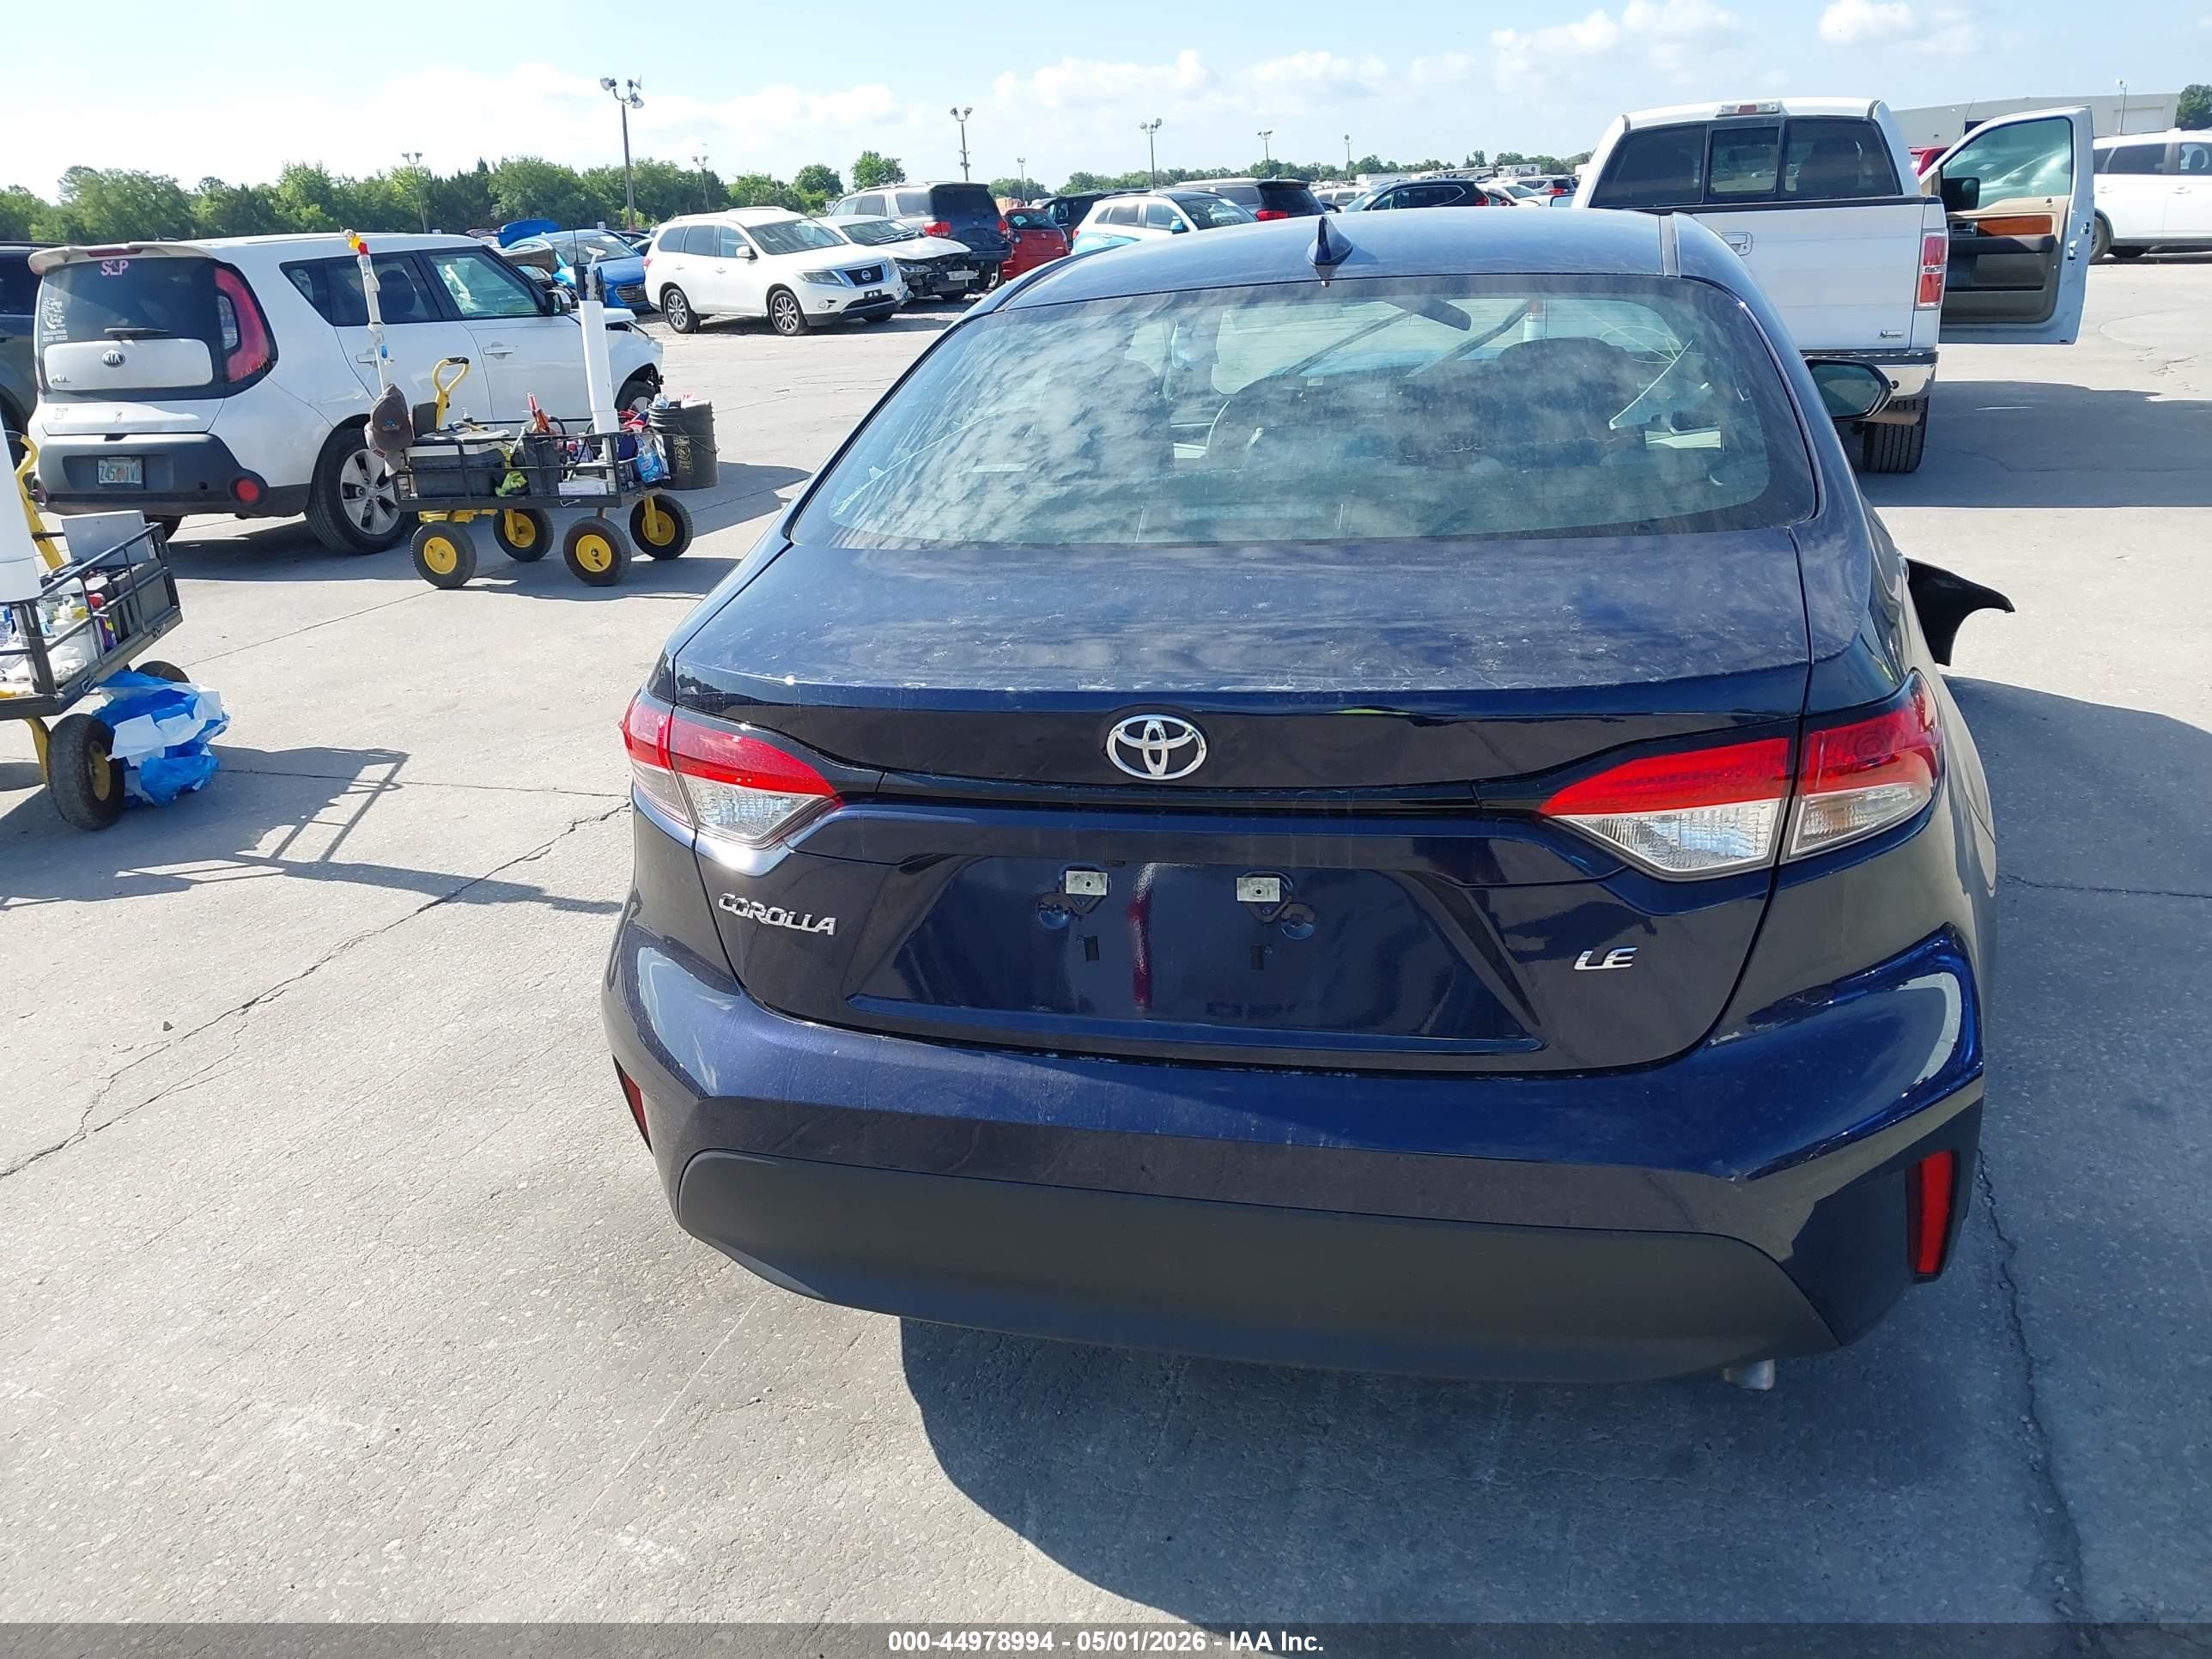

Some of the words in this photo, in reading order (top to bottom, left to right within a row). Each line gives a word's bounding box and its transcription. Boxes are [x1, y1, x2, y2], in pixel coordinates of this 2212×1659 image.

[102, 352, 123, 364] KIA
[719, 892, 837, 936] COROLLA
[1573, 947, 1638, 970] LE
